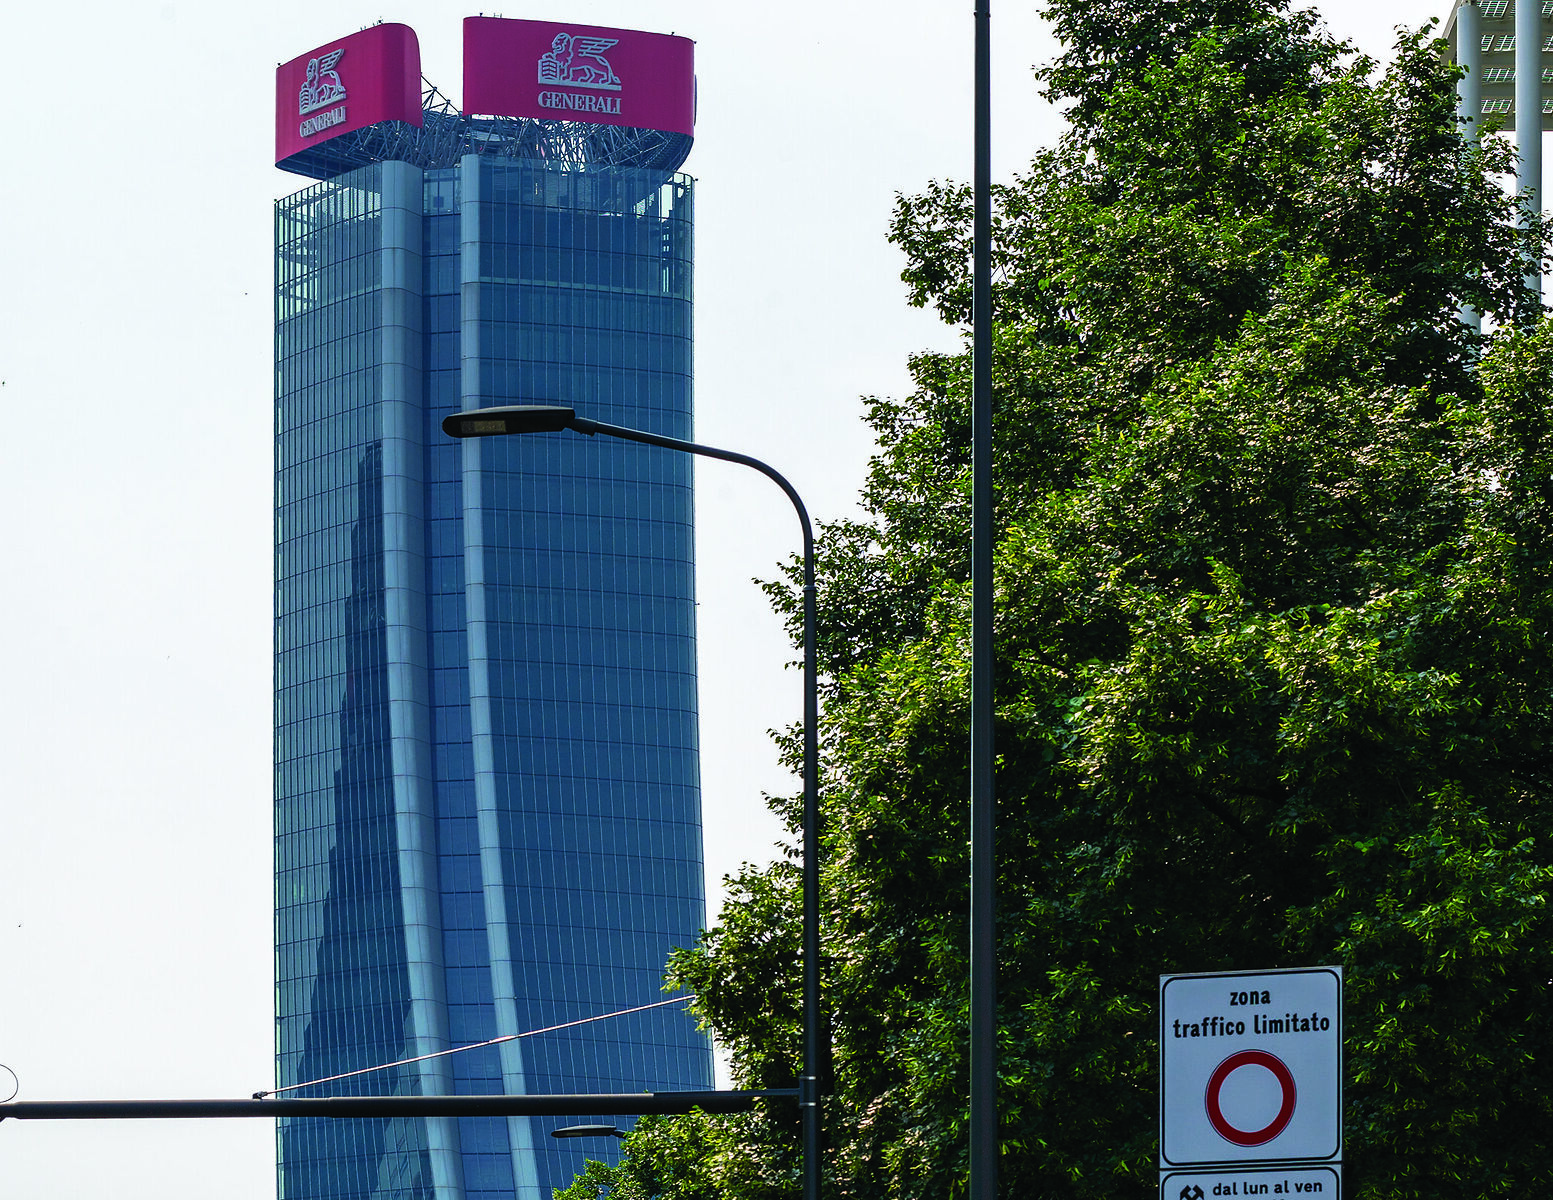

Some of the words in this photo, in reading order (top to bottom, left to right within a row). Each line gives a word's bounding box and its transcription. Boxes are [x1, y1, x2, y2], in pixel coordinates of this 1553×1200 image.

[538, 91, 622, 114] GENERALI
[300, 106, 346, 137] GENERALI
[1230, 990, 1271, 1006] zona
[1173, 1016, 1245, 1038] traffico
[1254, 1012, 1330, 1034] limitato
[1213, 1182, 1237, 1195] dal
[1243, 1182, 1268, 1194] lun
[1274, 1181, 1289, 1193] al
[1295, 1182, 1323, 1192] ven
